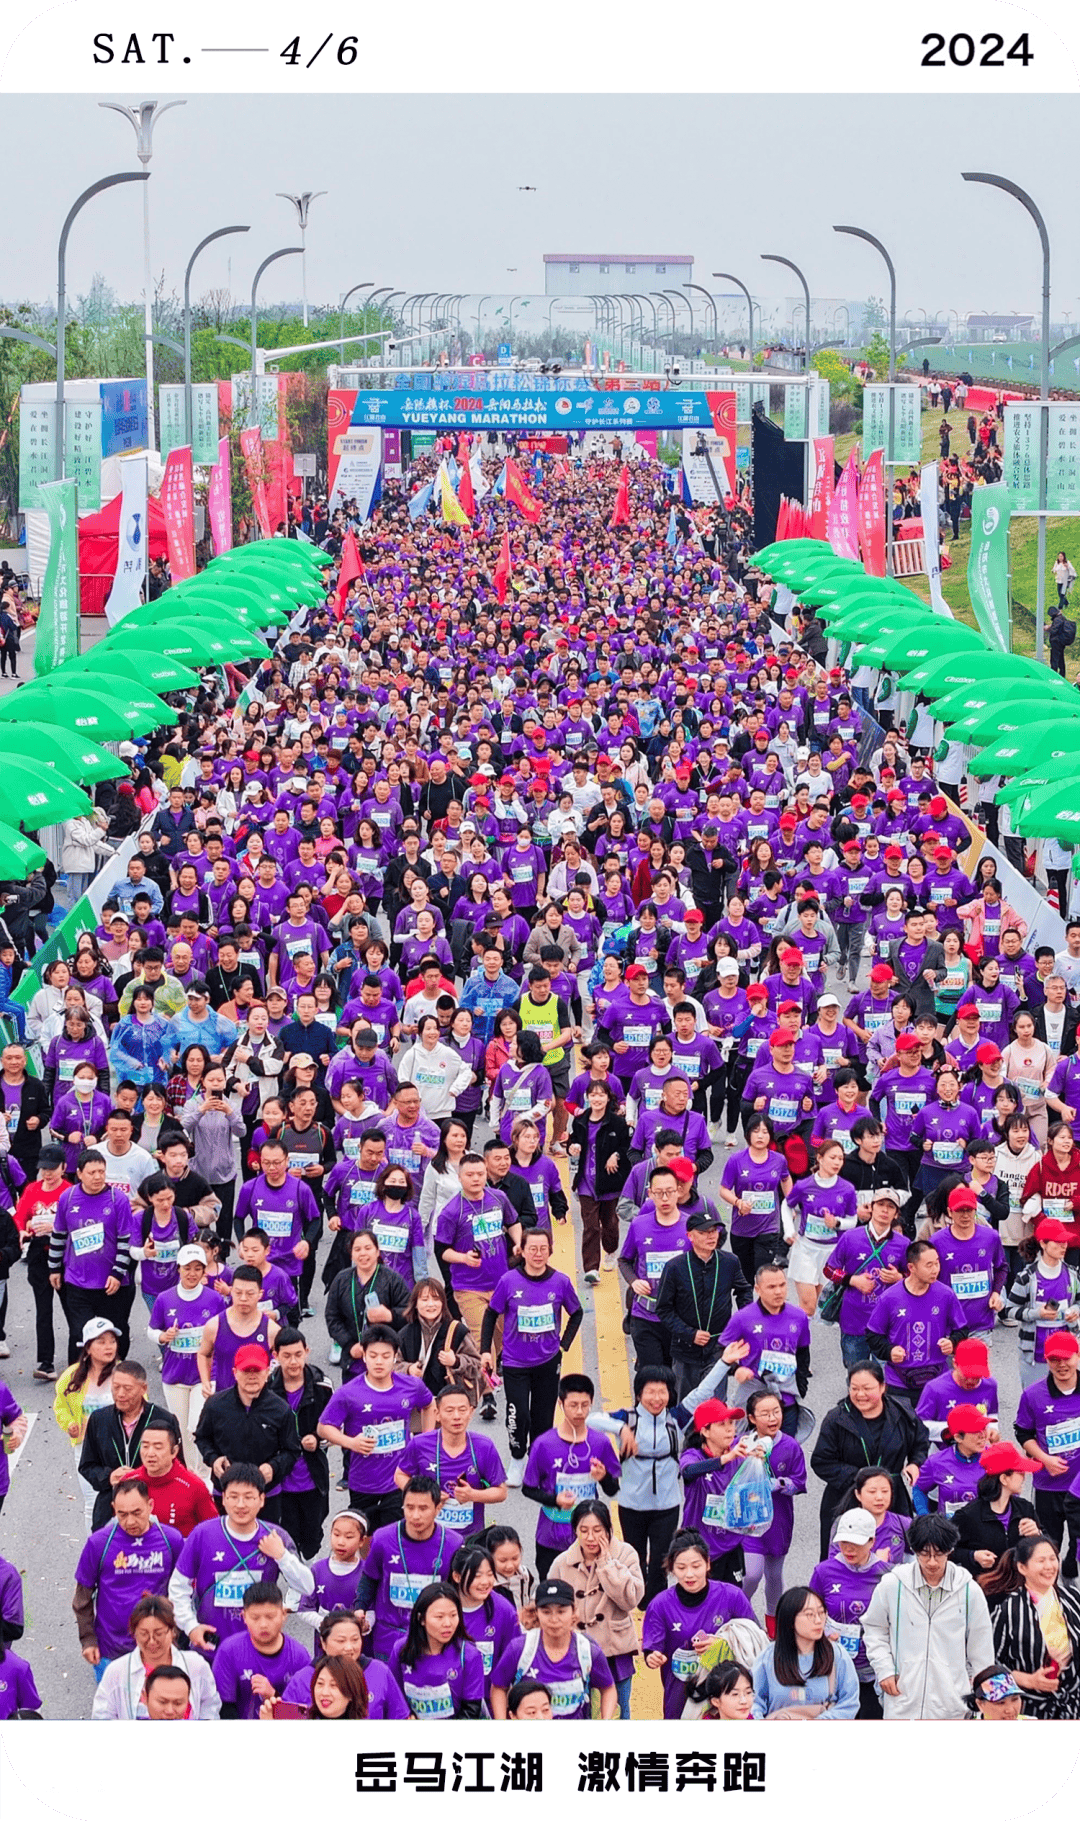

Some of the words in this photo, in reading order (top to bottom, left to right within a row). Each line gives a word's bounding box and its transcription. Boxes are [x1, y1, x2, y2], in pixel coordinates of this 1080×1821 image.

[454, 397, 483, 411] 2024
[402, 413, 466, 424] YUEYANG
[471, 413, 547, 424] MARATHON
